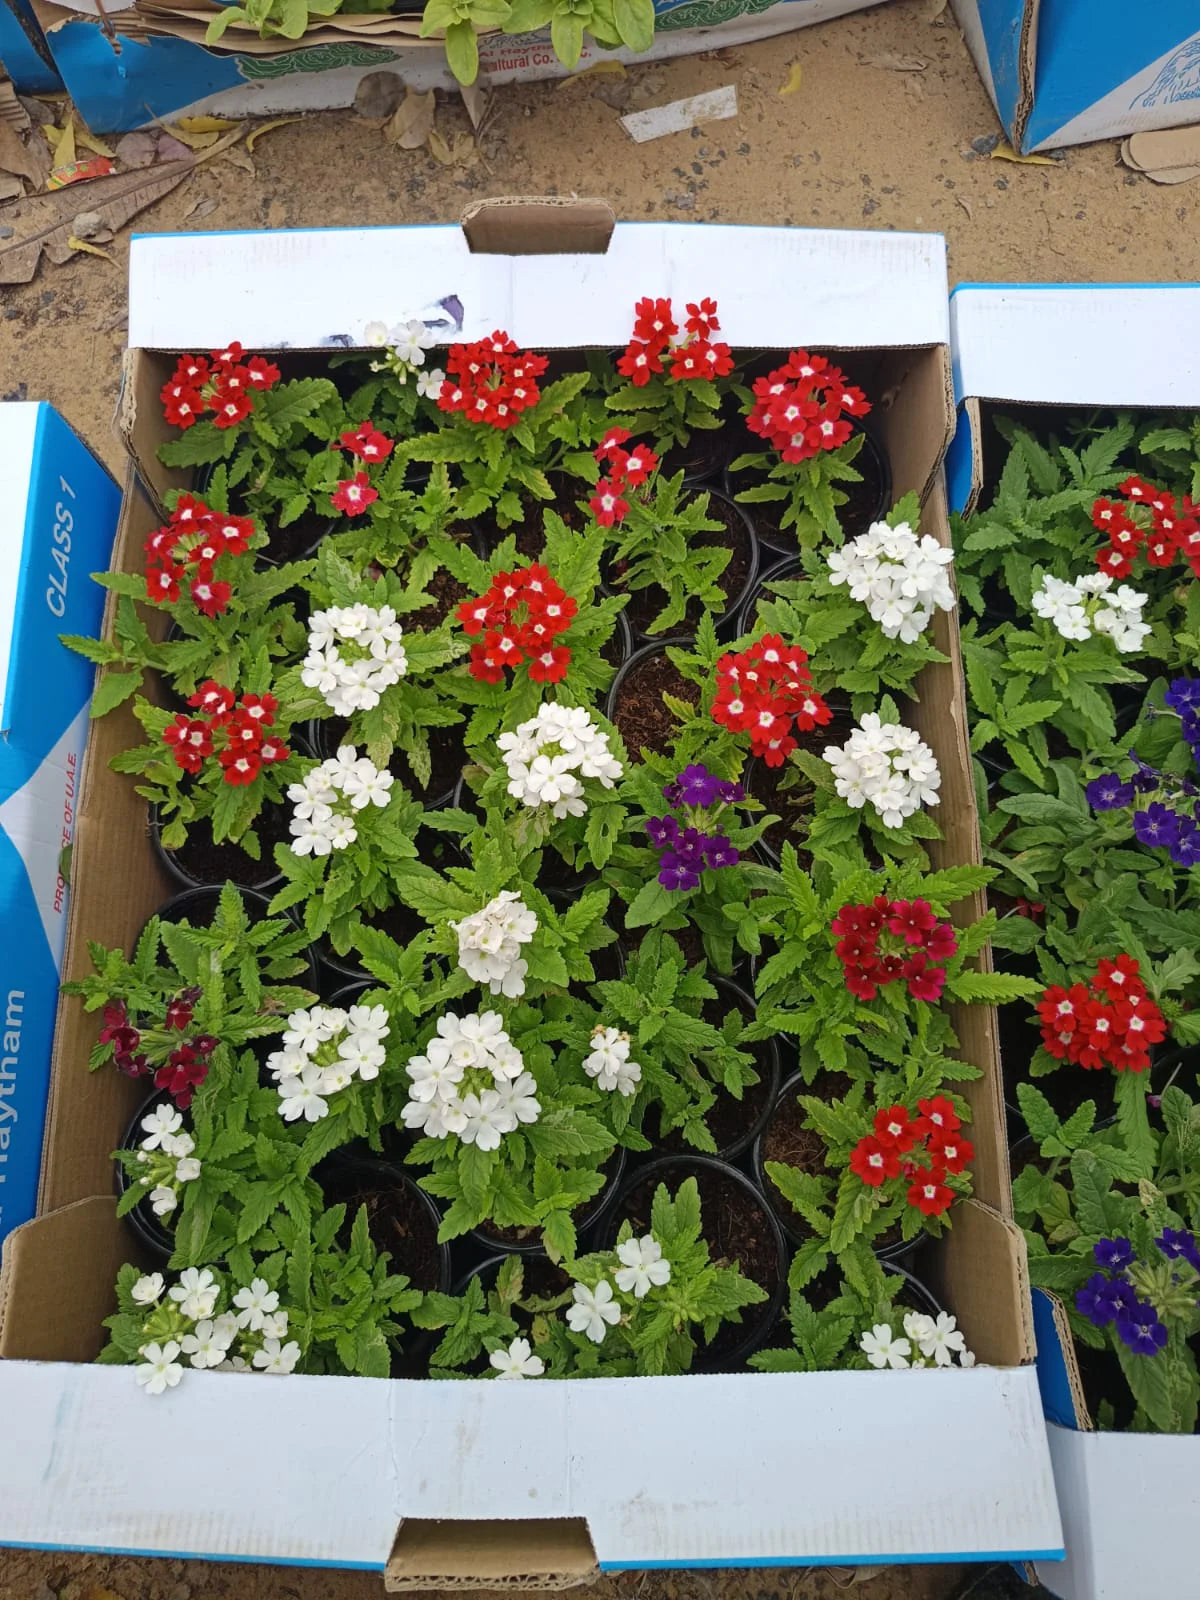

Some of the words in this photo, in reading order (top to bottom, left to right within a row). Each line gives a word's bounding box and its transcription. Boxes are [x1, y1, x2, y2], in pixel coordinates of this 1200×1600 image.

[490, 54, 529, 71] ultural
[532, 52, 554, 66] Co.
[59, 474, 77, 499] 1
[46, 501, 74, 617] CLASS
[64, 752, 77, 799] U.A.E.
[63, 799, 74, 825] OF
[53, 826, 72, 914] PROCE
